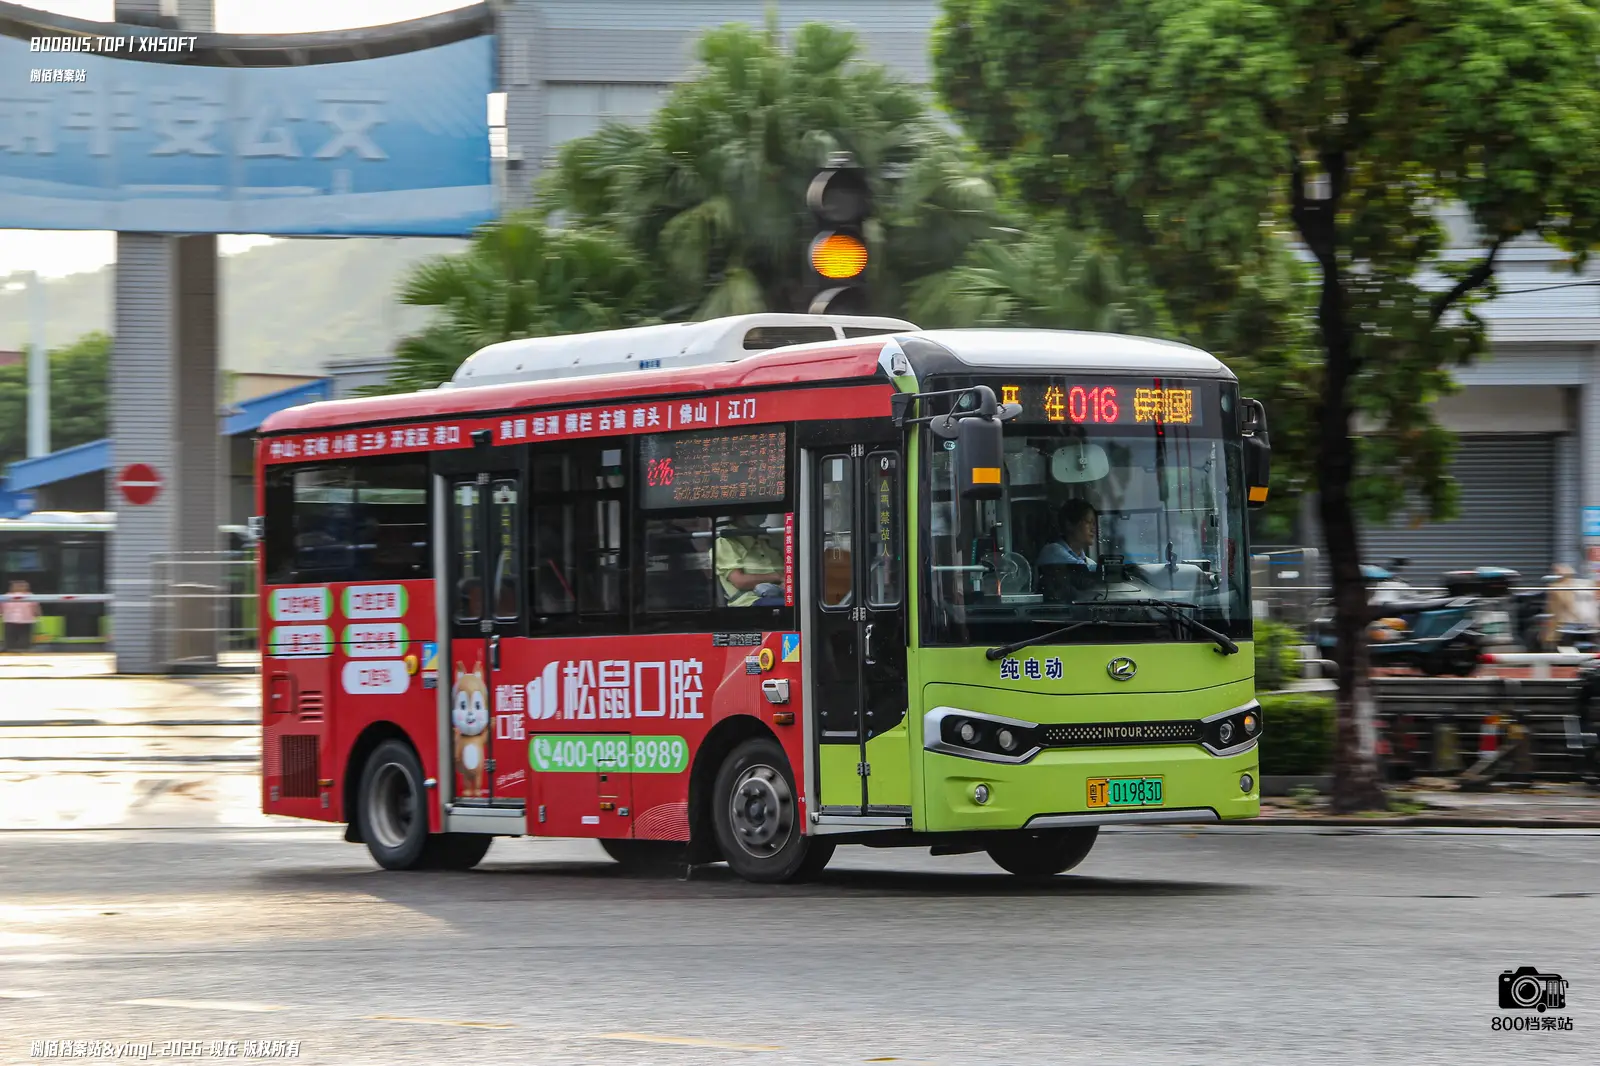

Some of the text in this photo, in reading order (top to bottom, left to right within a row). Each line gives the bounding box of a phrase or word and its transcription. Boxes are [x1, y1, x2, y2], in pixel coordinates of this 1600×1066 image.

[1069, 386, 1119, 423] 016
[361, 431, 386, 450] 三乡
[390, 428, 430, 448] 开发区
[434, 426, 460, 444] 港口
[500, 419, 527, 440] 黄圃
[599, 409, 626, 431] 古镇
[633, 407, 660, 428] 南头
[679, 402, 707, 424] 佛山
[728, 398, 756, 419] 江门
[648, 457, 675, 486] 016
[1000, 657, 1063, 680] 纯电动
[563, 658, 704, 720] 松鼠口腔
[1103, 726, 1142, 738] INTOUR
[552, 740, 683, 768] 400-088-8989
